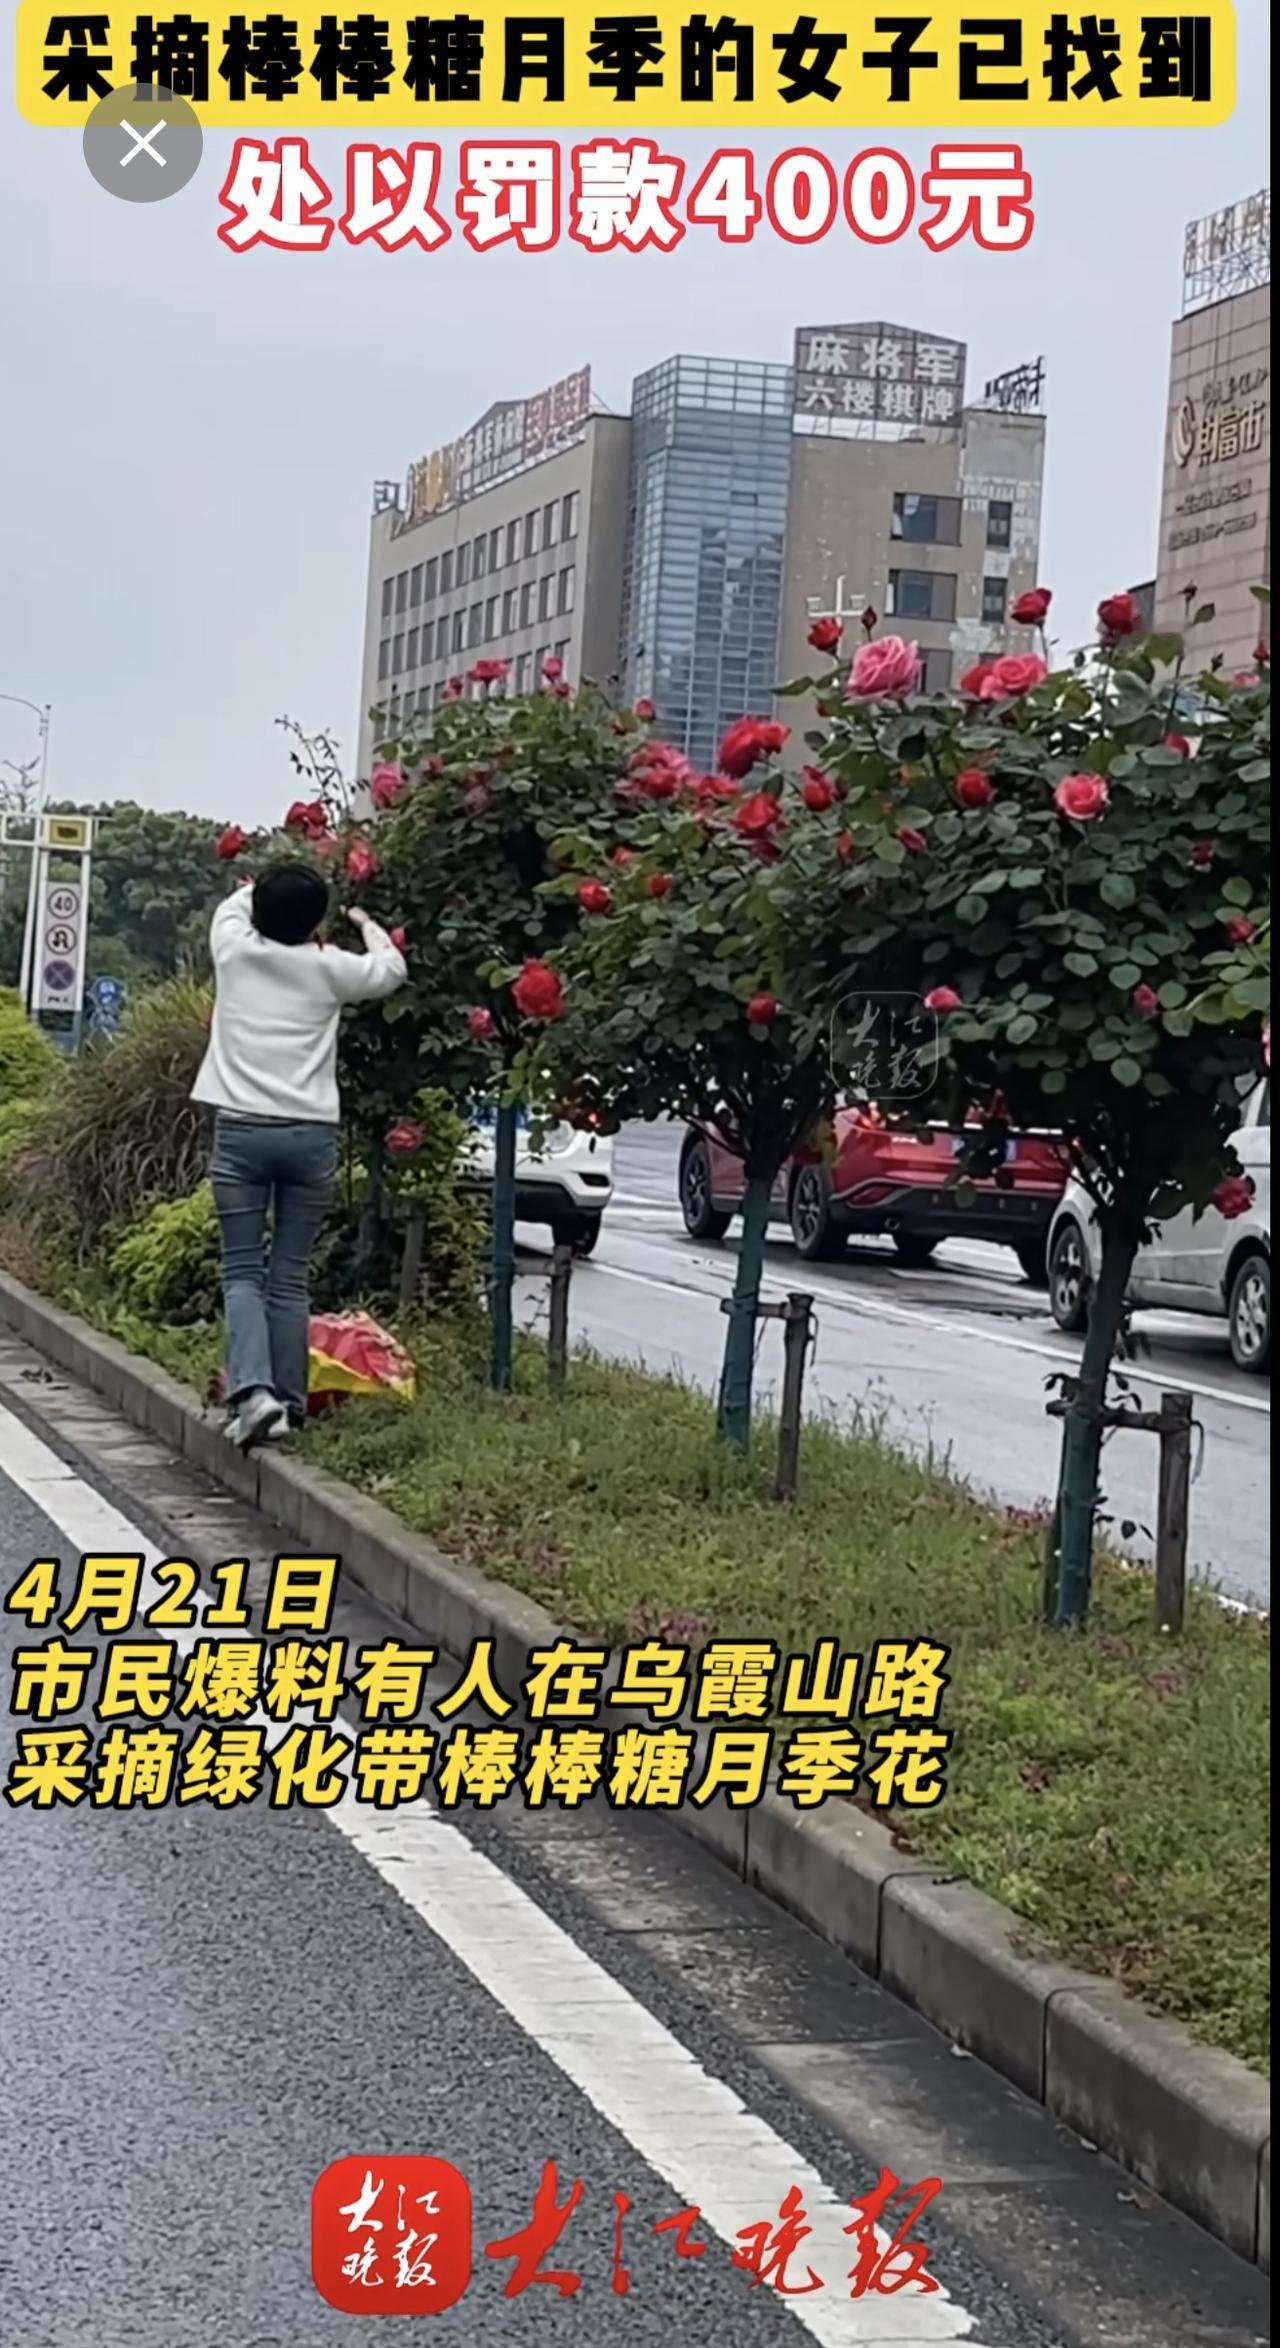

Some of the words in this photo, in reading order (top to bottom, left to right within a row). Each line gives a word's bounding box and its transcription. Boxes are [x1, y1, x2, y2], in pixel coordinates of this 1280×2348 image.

[805, 333, 957, 384] 麻将军
[804, 378, 955, 423] 六楼棋牌
[54, 897, 73, 911] 40
